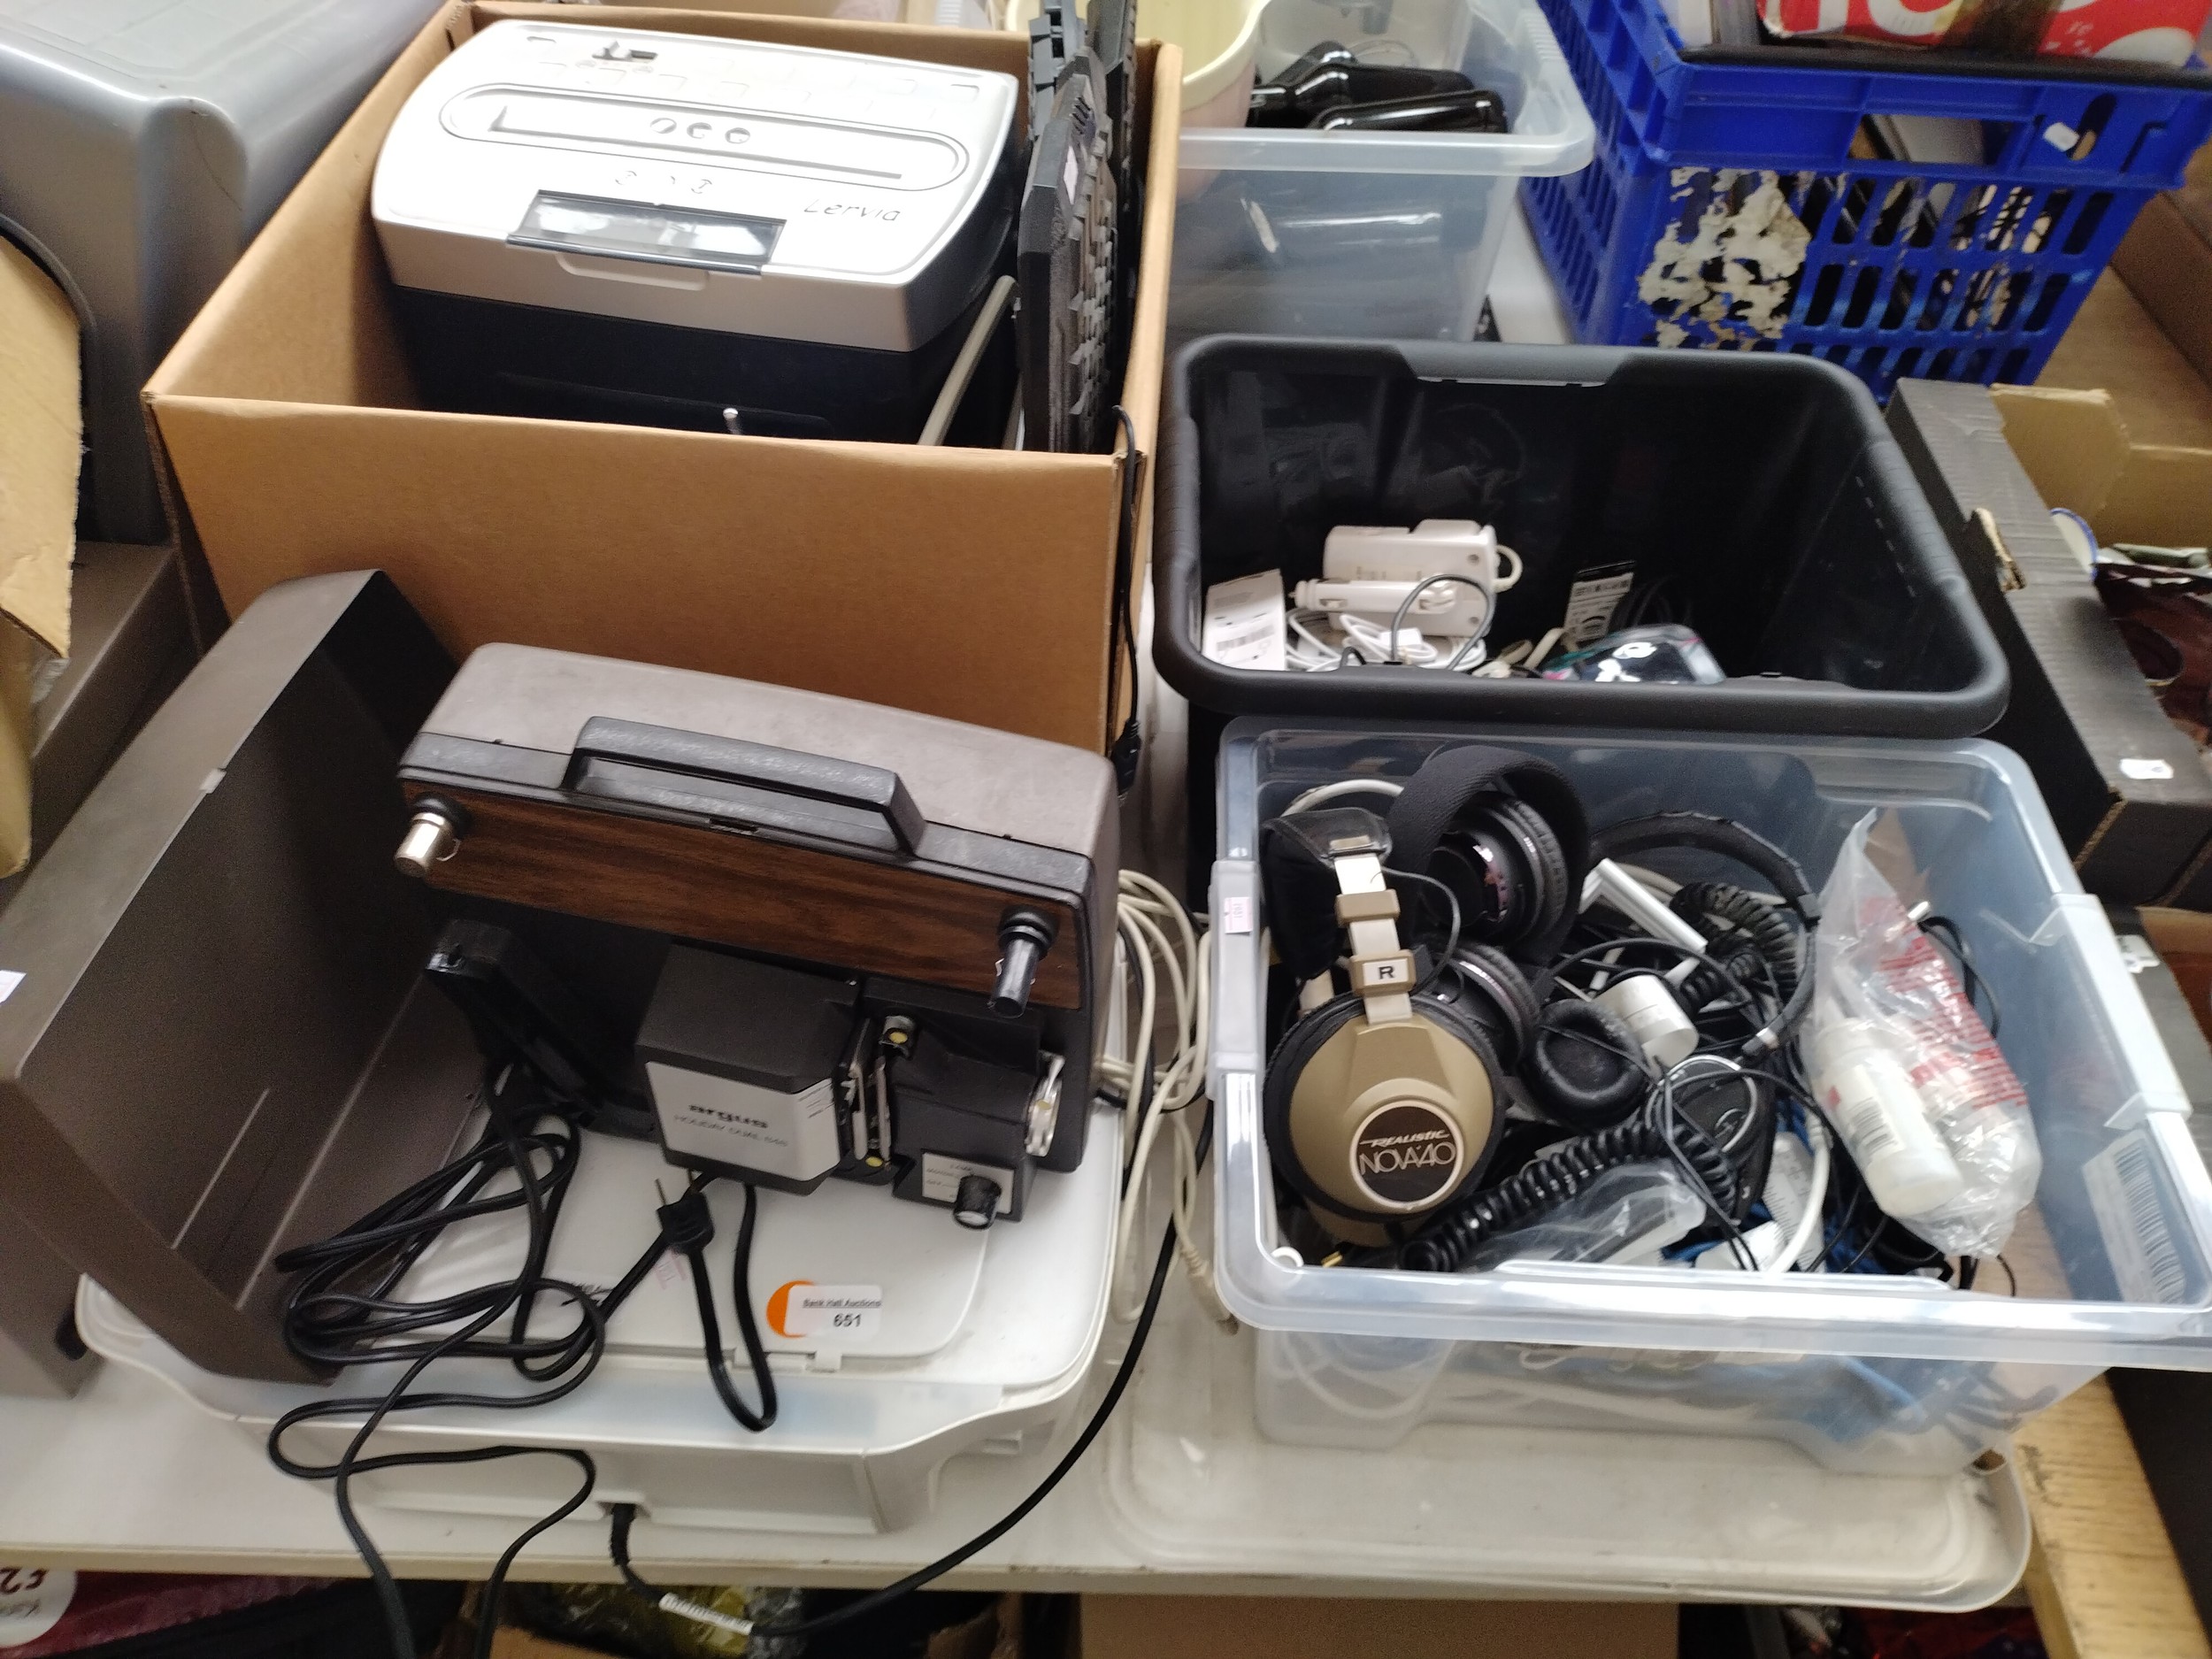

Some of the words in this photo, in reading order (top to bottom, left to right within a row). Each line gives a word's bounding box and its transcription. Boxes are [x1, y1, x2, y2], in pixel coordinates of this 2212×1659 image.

[803, 198, 901, 221] Lervia
[1379, 965, 1394, 979] R
[688, 1103, 768, 1129] argus
[1359, 1129, 1449, 1148] REALISTIC
[833, 1313, 862, 1327] 651
